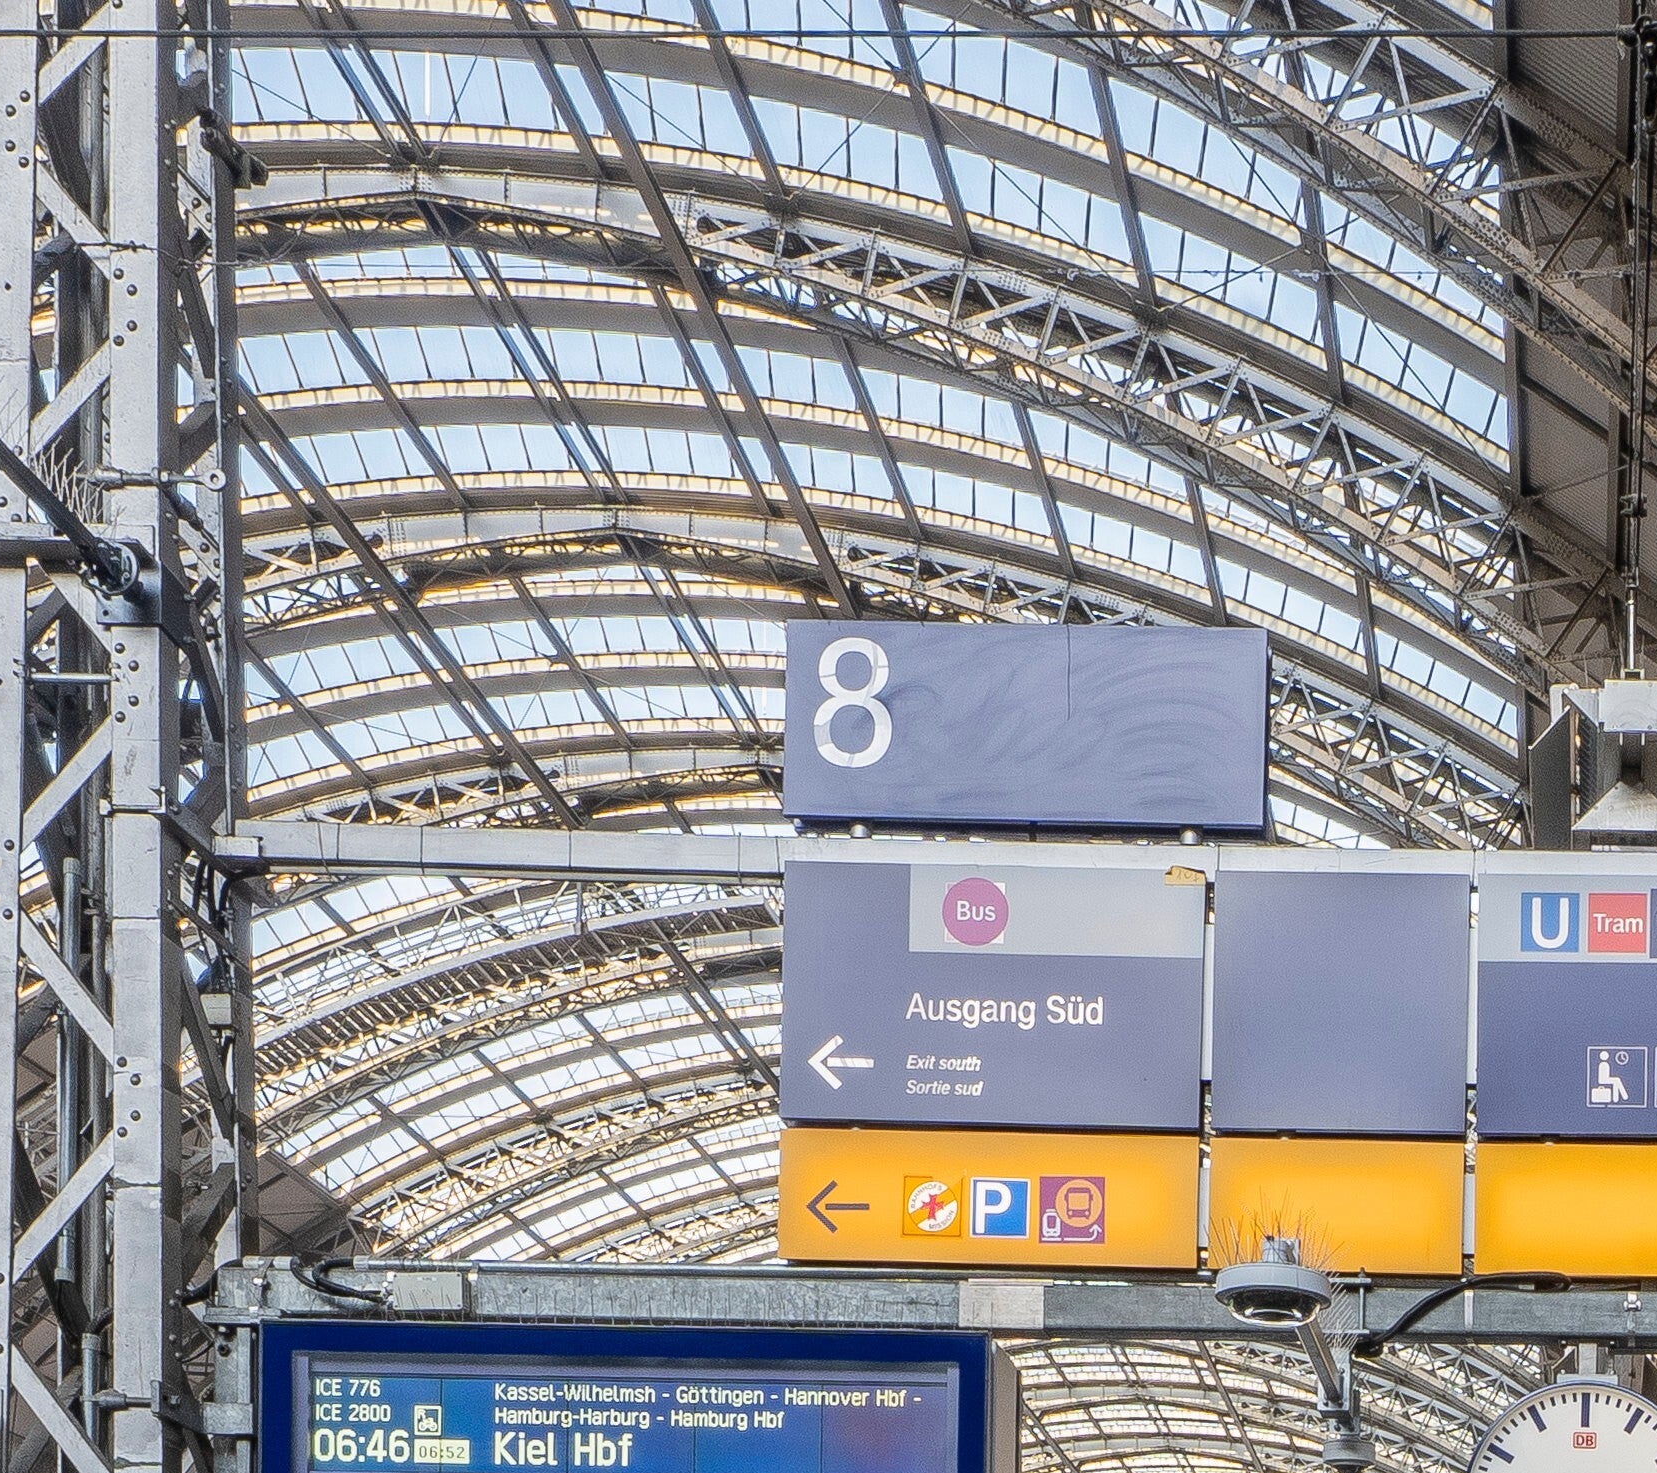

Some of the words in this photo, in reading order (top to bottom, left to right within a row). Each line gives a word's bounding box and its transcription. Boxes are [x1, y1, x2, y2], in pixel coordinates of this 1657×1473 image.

[813, 637, 893, 769] 8
[956, 901, 996, 921] Bus
[1531, 897, 1569, 949] U
[1593, 913, 1643, 934] Tram
[905, 993, 1036, 1030] Ausgang
[1046, 995, 1104, 1025] Süd
[906, 1055, 936, 1071] Exit
[939, 1056, 981, 1072] south
[906, 1080, 950, 1095] Sortie
[954, 1081, 984, 1096] sud
[976, 1181, 1013, 1234] P
[315, 1379, 342, 1397] ICE
[348, 1379, 381, 1398] 776
[494, 1383, 656, 1404] Kassel-Wilhelmsh
[675, 1385, 764, 1407] Göttingen
[784, 1387, 870, 1408] Hannover
[876, 1389, 908, 1408] Hbf
[315, 1404, 342, 1421] ICE
[348, 1404, 391, 1423] 2800
[494, 1407, 650, 1429] Hamburg-Harburg
[670, 1410, 749, 1431] Hamburg
[753, 1410, 785, 1429] Hbf
[313, 1428, 410, 1464] 06:46
[418, 1445, 466, 1459] 06:52
[494, 1431, 558, 1467] Kiel
[574, 1432, 633, 1468] Hbf
[1576, 1434, 1595, 1449] DB
